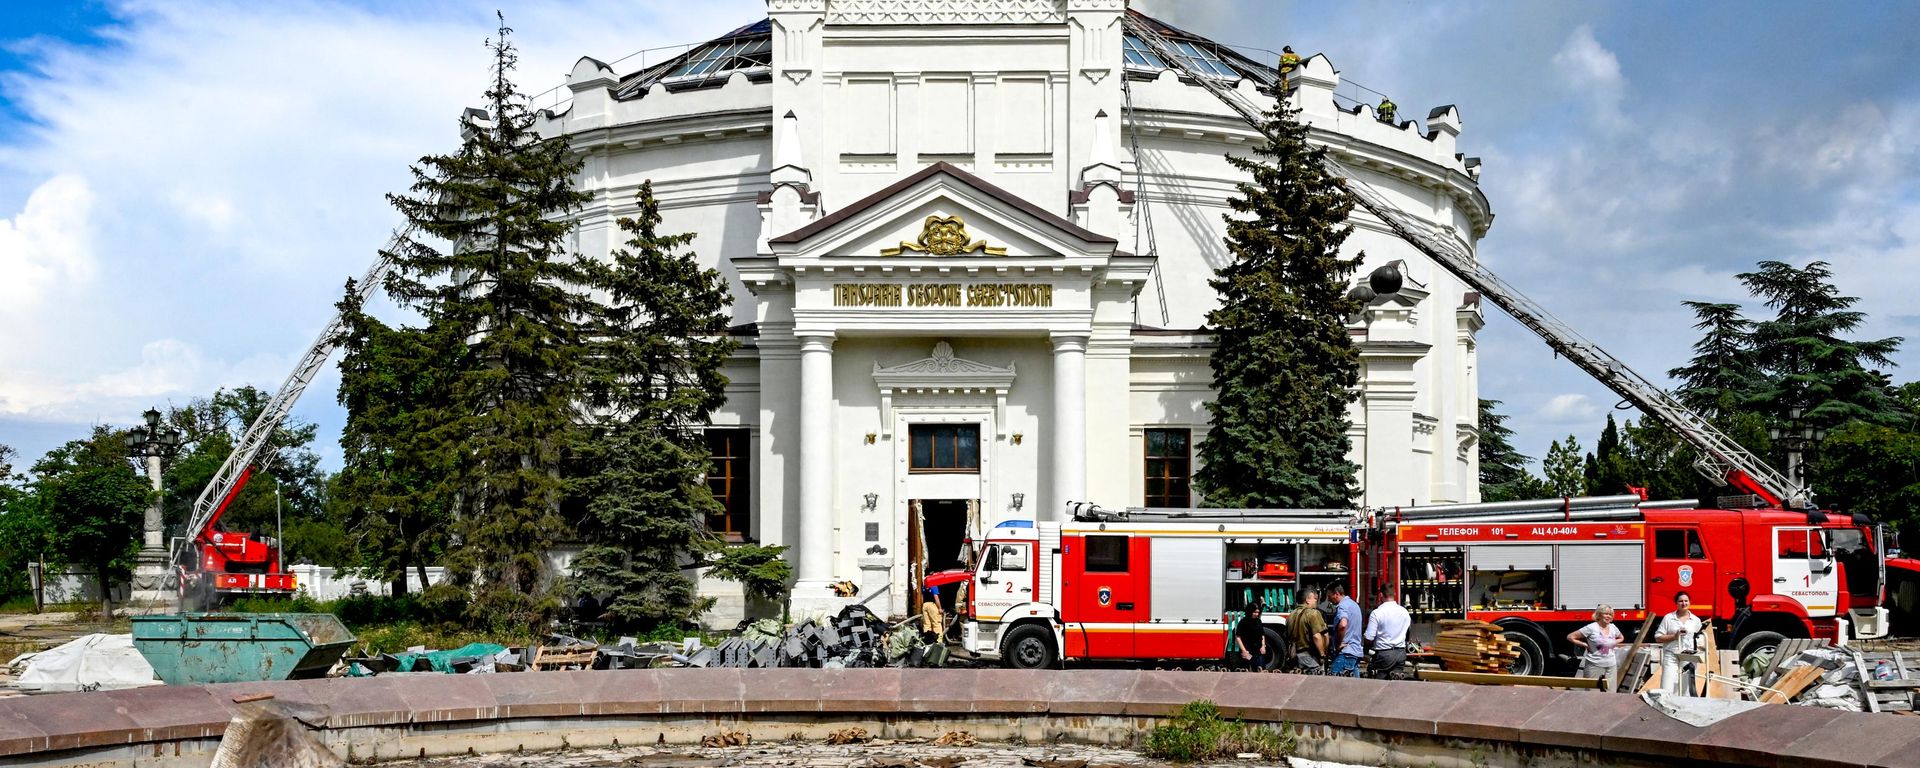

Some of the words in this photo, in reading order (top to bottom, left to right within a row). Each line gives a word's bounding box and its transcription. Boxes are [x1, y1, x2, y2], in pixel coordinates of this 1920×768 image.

[833, 284, 903, 306] ПАНОРАМА
[907, 284, 961, 306] ОБОРОНЫ
[966, 284, 1053, 307] СЕВАСТОПОЛЯ
[1438, 528, 1479, 536] ТЕЛЕФОН
[1531, 528, 1545, 536] АЦ
[1546, 527, 1578, 535] 4,0-40/4
[1006, 581, 1013, 593] 2
[1803, 575, 1809, 588] 1
